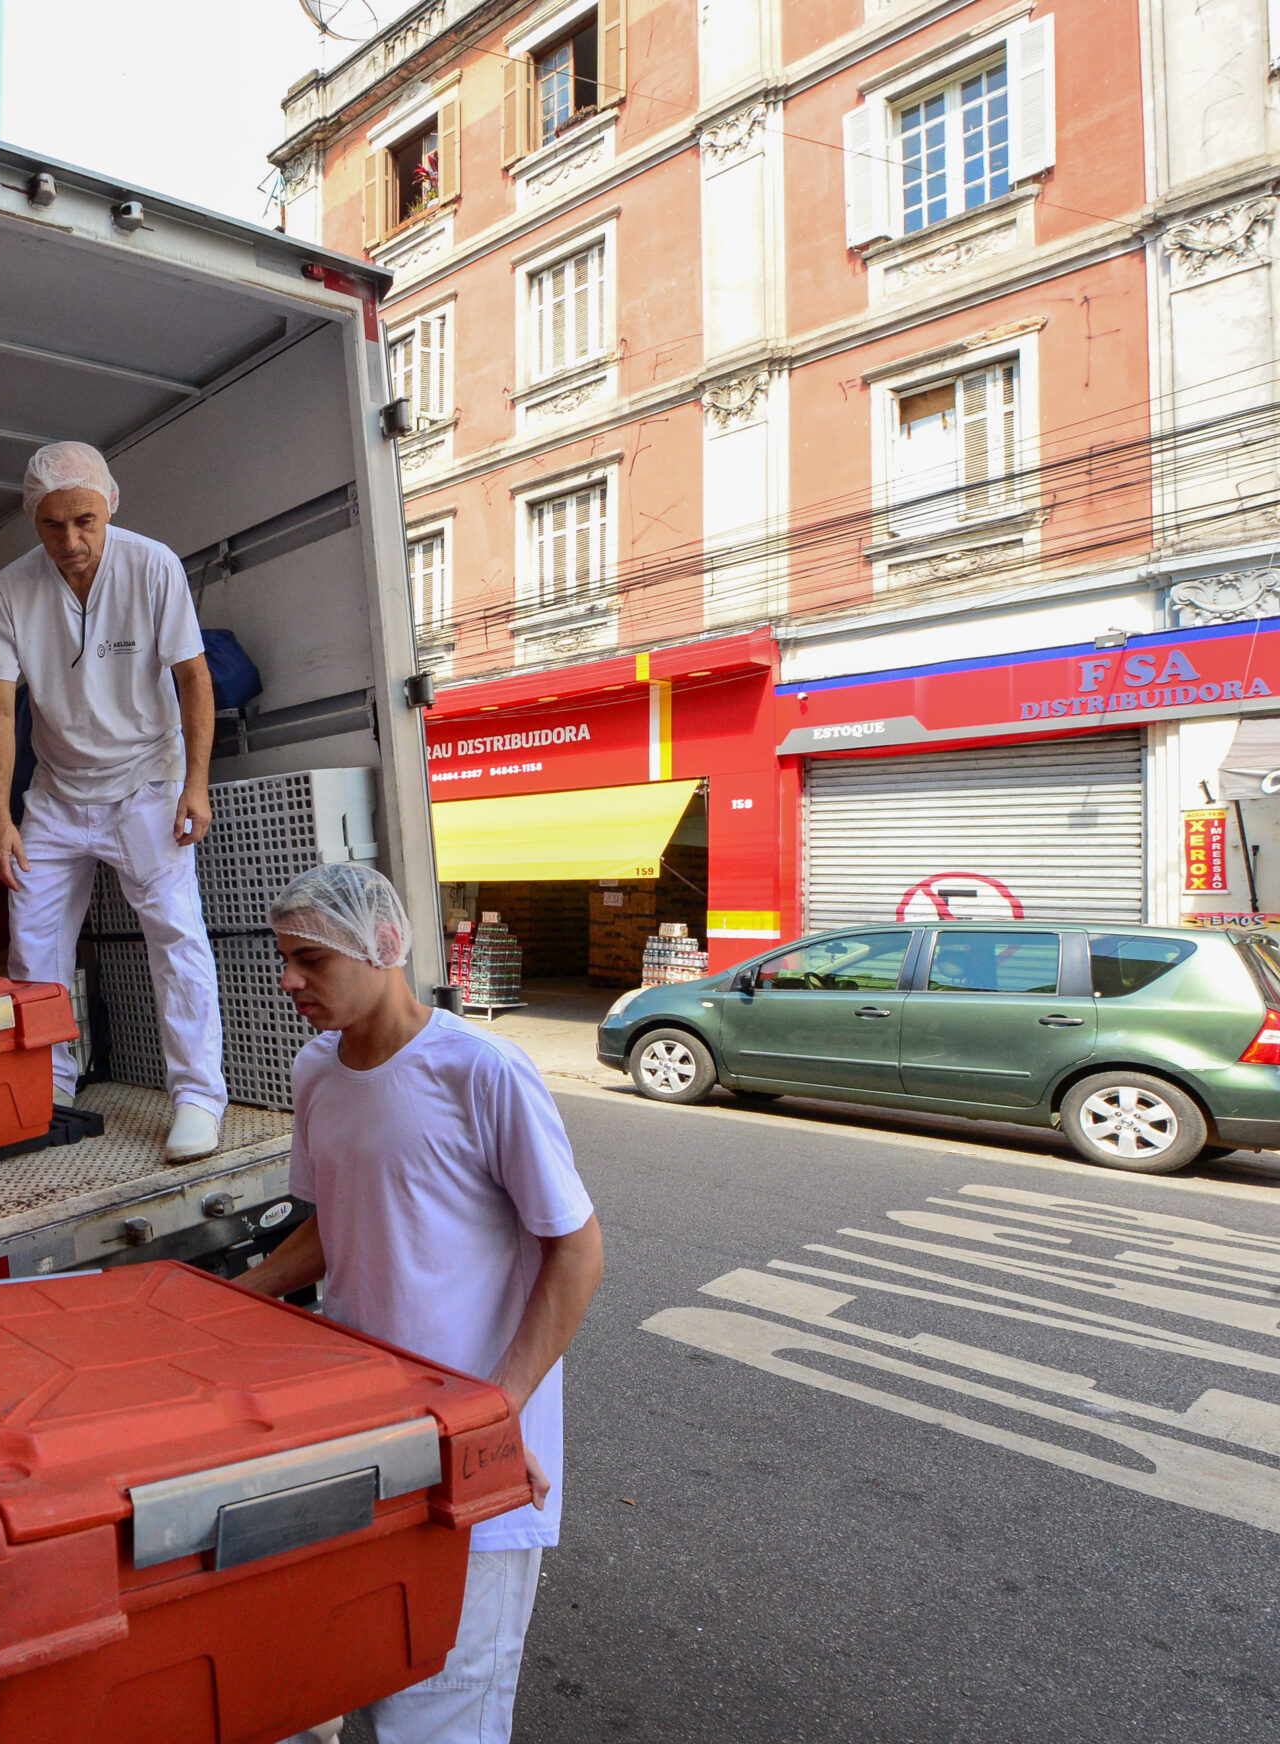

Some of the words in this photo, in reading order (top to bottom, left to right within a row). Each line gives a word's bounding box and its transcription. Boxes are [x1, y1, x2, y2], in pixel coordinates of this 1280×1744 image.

[1020, 677, 1272, 720] DISTRIBUIDORA
[457, 723, 591, 757] DISTRIBUIDORA
[812, 721, 886, 740] ESTOQUE
[635, 866, 655, 876] 159
[1189, 821, 1208, 890] XEROX
[1210, 820, 1223, 889] IMPRESSÃO
[1196, 915, 1266, 927] TEMOS
